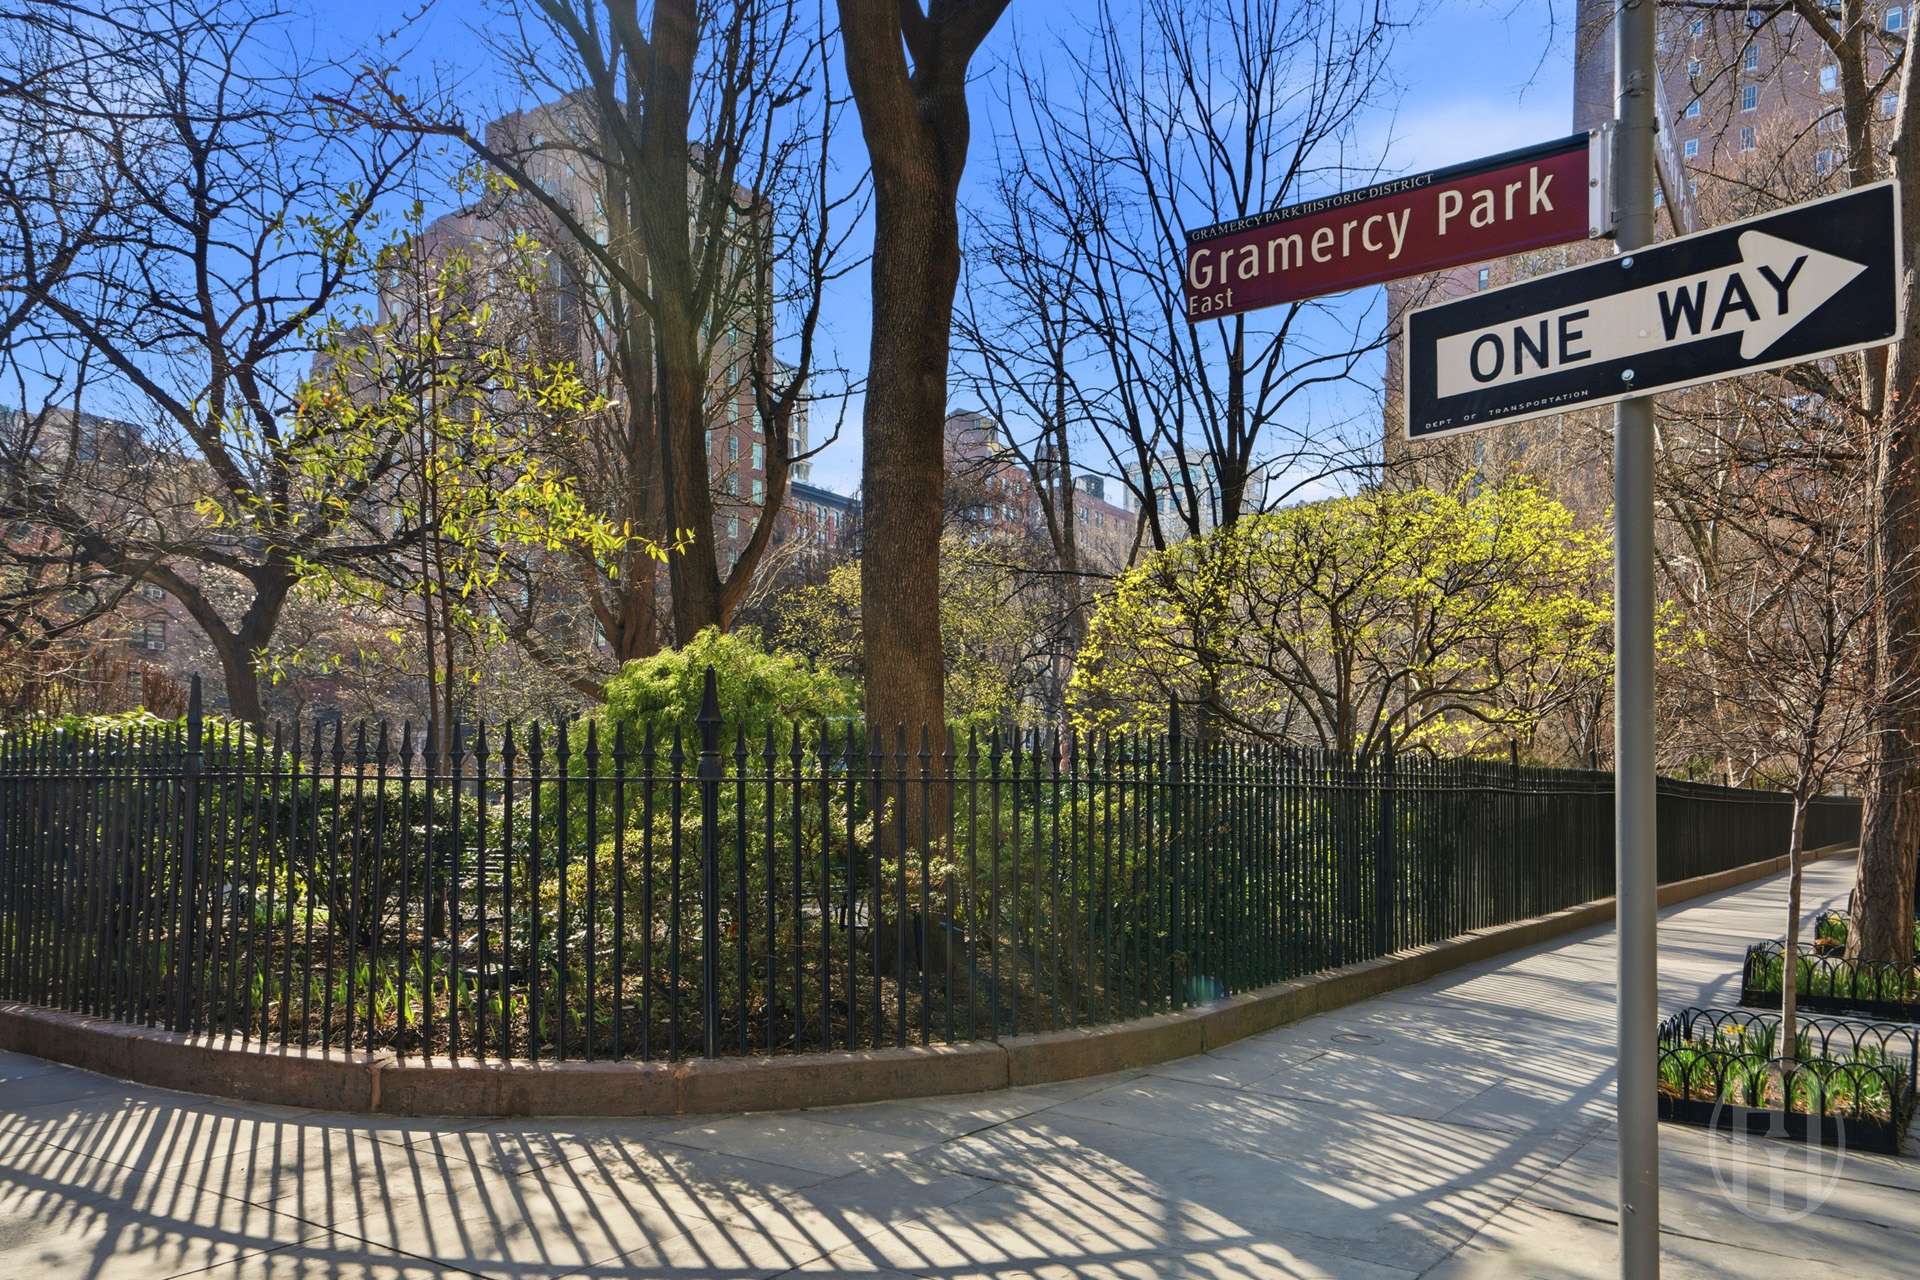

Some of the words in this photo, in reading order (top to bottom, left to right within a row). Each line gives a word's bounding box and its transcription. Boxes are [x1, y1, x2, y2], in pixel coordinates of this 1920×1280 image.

[1190, 208, 1410, 290] Gramercy
[1438, 166, 1555, 236] Park
[1191, 215, 1262, 241] GRAMERCY
[1265, 207, 1300, 223] PARK
[1303, 191, 1366, 213] HISTORIC
[1369, 174, 1433, 198] DISTRICT
[1189, 287, 1233, 316] East
[1470, 310, 1592, 383] ONE
[1658, 255, 1808, 341] WAY
[1425, 418, 1452, 430] DEPT
[1463, 413, 1477, 422] OF
[1488, 389, 1589, 416] TRANSPORTATION
